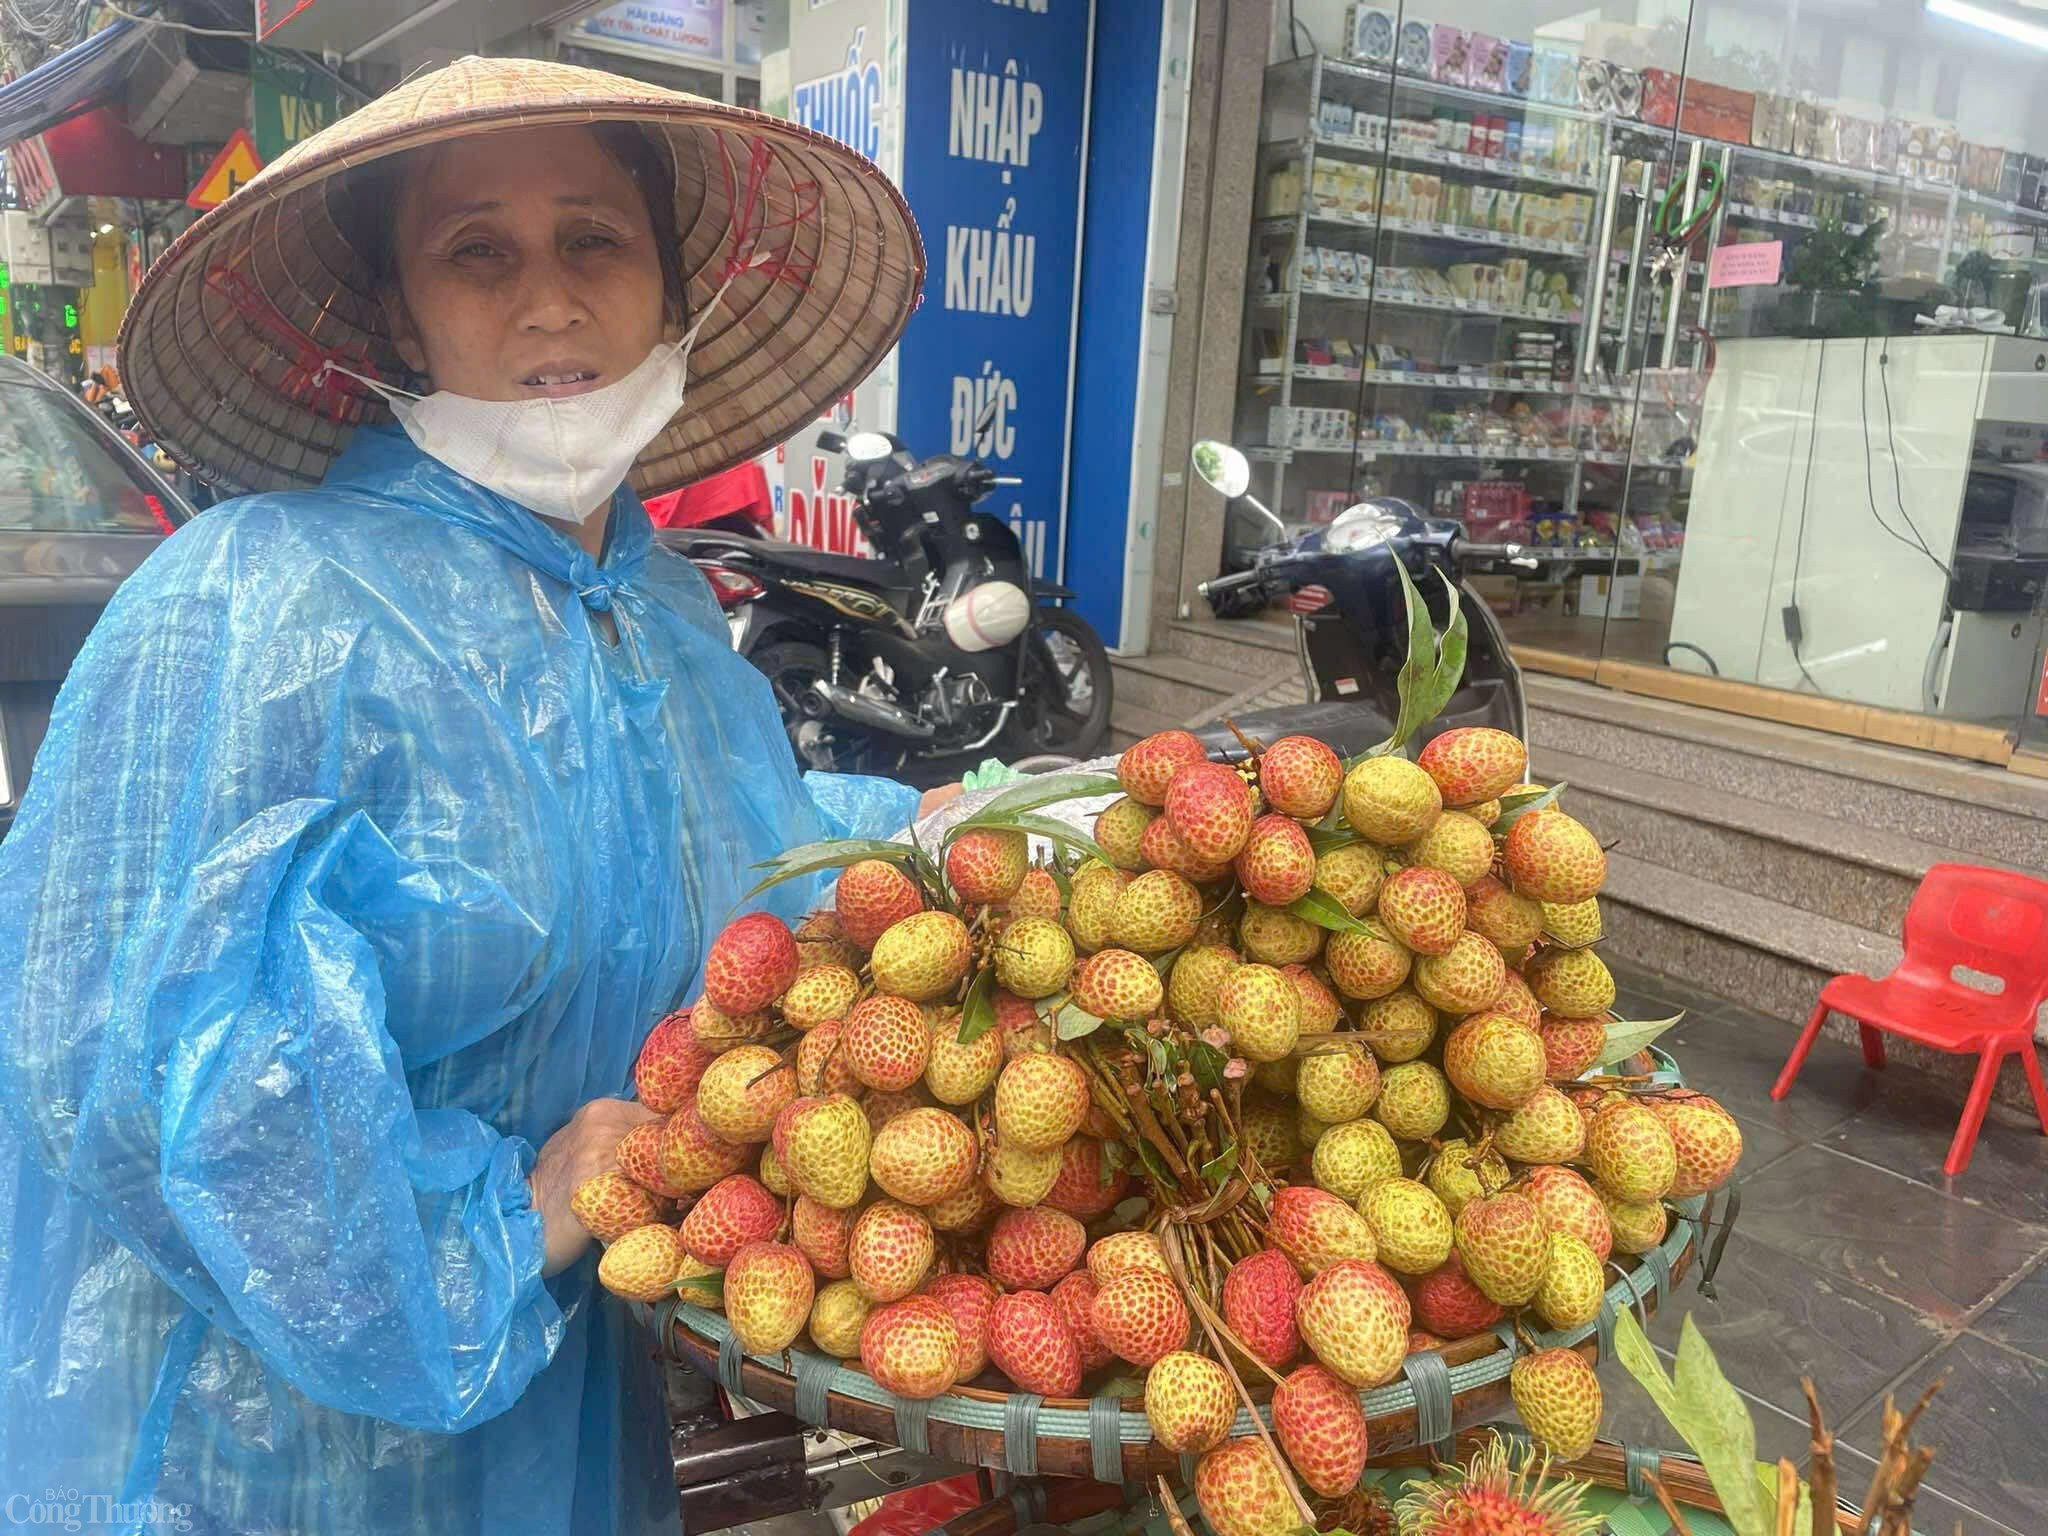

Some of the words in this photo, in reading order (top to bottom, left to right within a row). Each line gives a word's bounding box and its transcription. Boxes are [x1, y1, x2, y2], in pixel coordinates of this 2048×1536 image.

[949, 59, 1043, 185] NHẬP
[945, 197, 1035, 318] KHẨU
[950, 361, 1017, 459] ĐỨC
